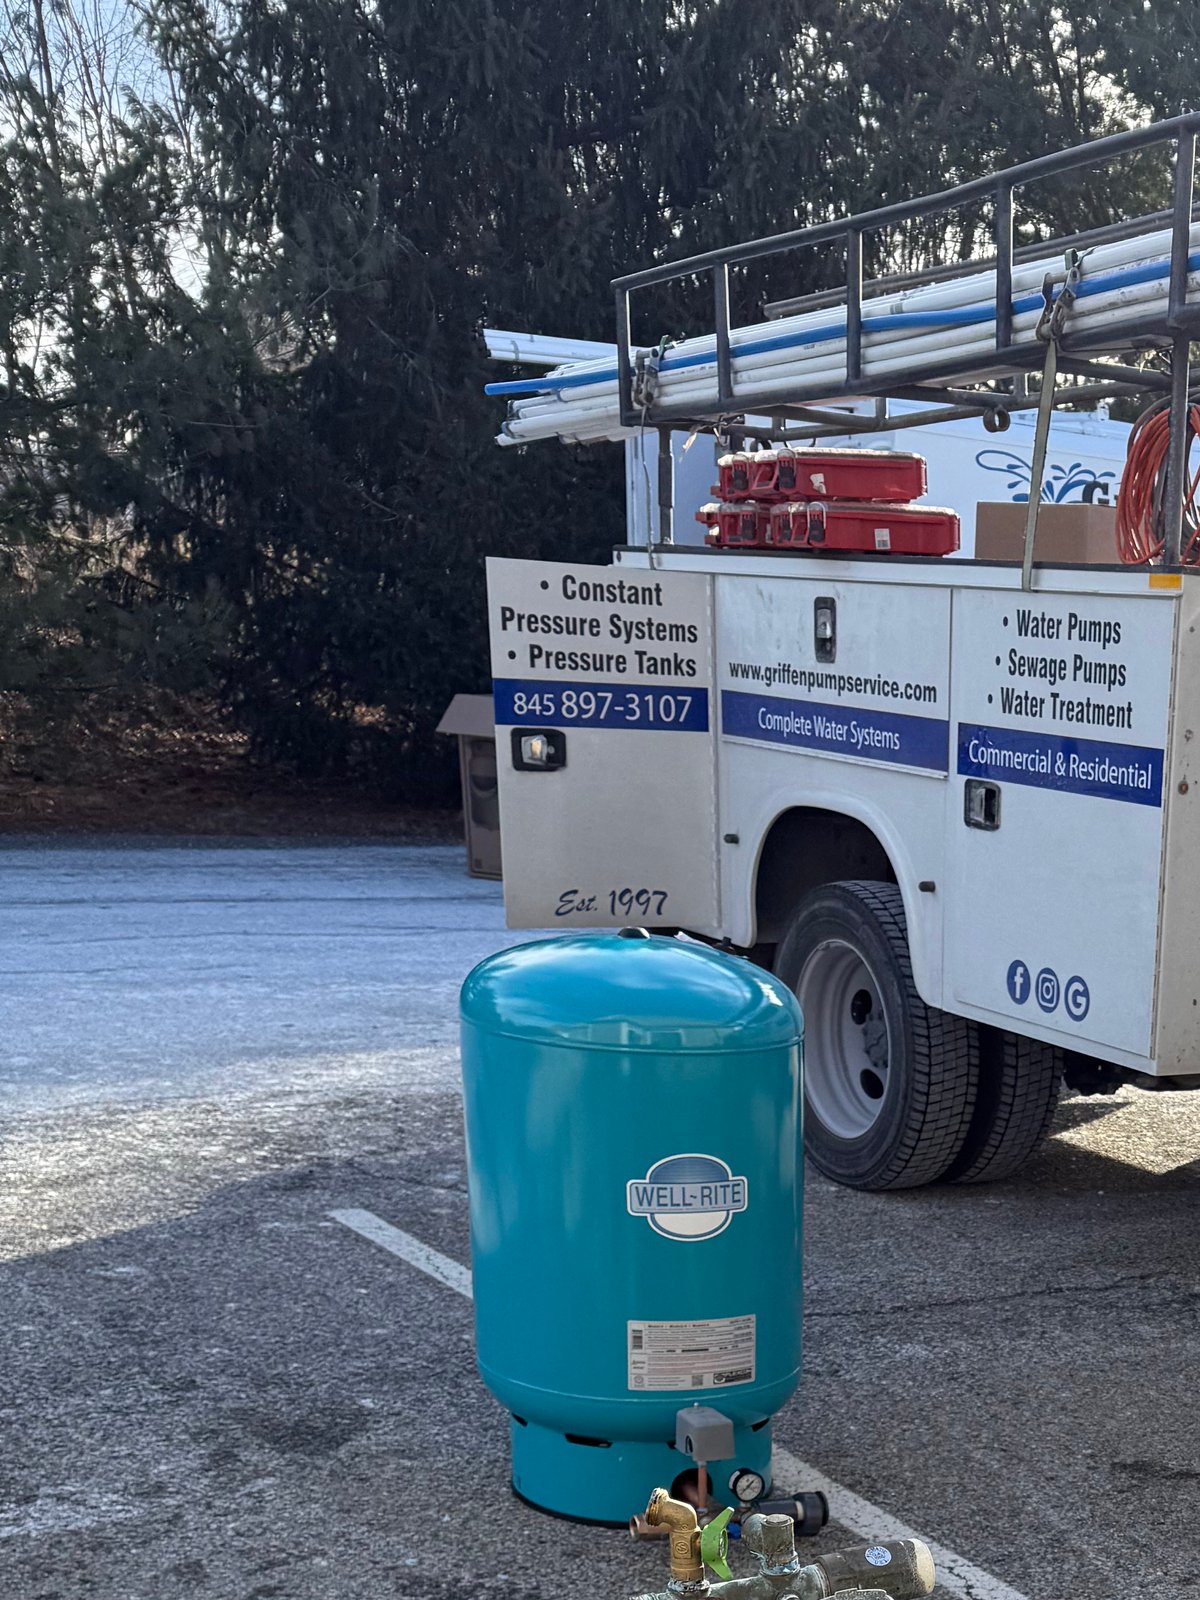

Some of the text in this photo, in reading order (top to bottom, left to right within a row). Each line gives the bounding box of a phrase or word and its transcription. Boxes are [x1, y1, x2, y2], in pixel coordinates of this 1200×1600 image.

[562, 574, 663, 606] Constant
[500, 606, 698, 644] Pressure Systems
[1017, 609, 1121, 650] Water Pumps
[528, 644, 697, 677] Pressure Tanks
[1008, 648, 1126, 691] Sewage Pumps
[729, 662, 937, 703] www.griffenpumpservice.com
[513, 690, 692, 722] 845 897-3107
[1000, 686, 1132, 729] Water Treatment
[758, 707, 900, 750] Complete Water Systems
[968, 740, 1152, 790] Commercial & Residential
[555, 888, 668, 916] Est. 1997
